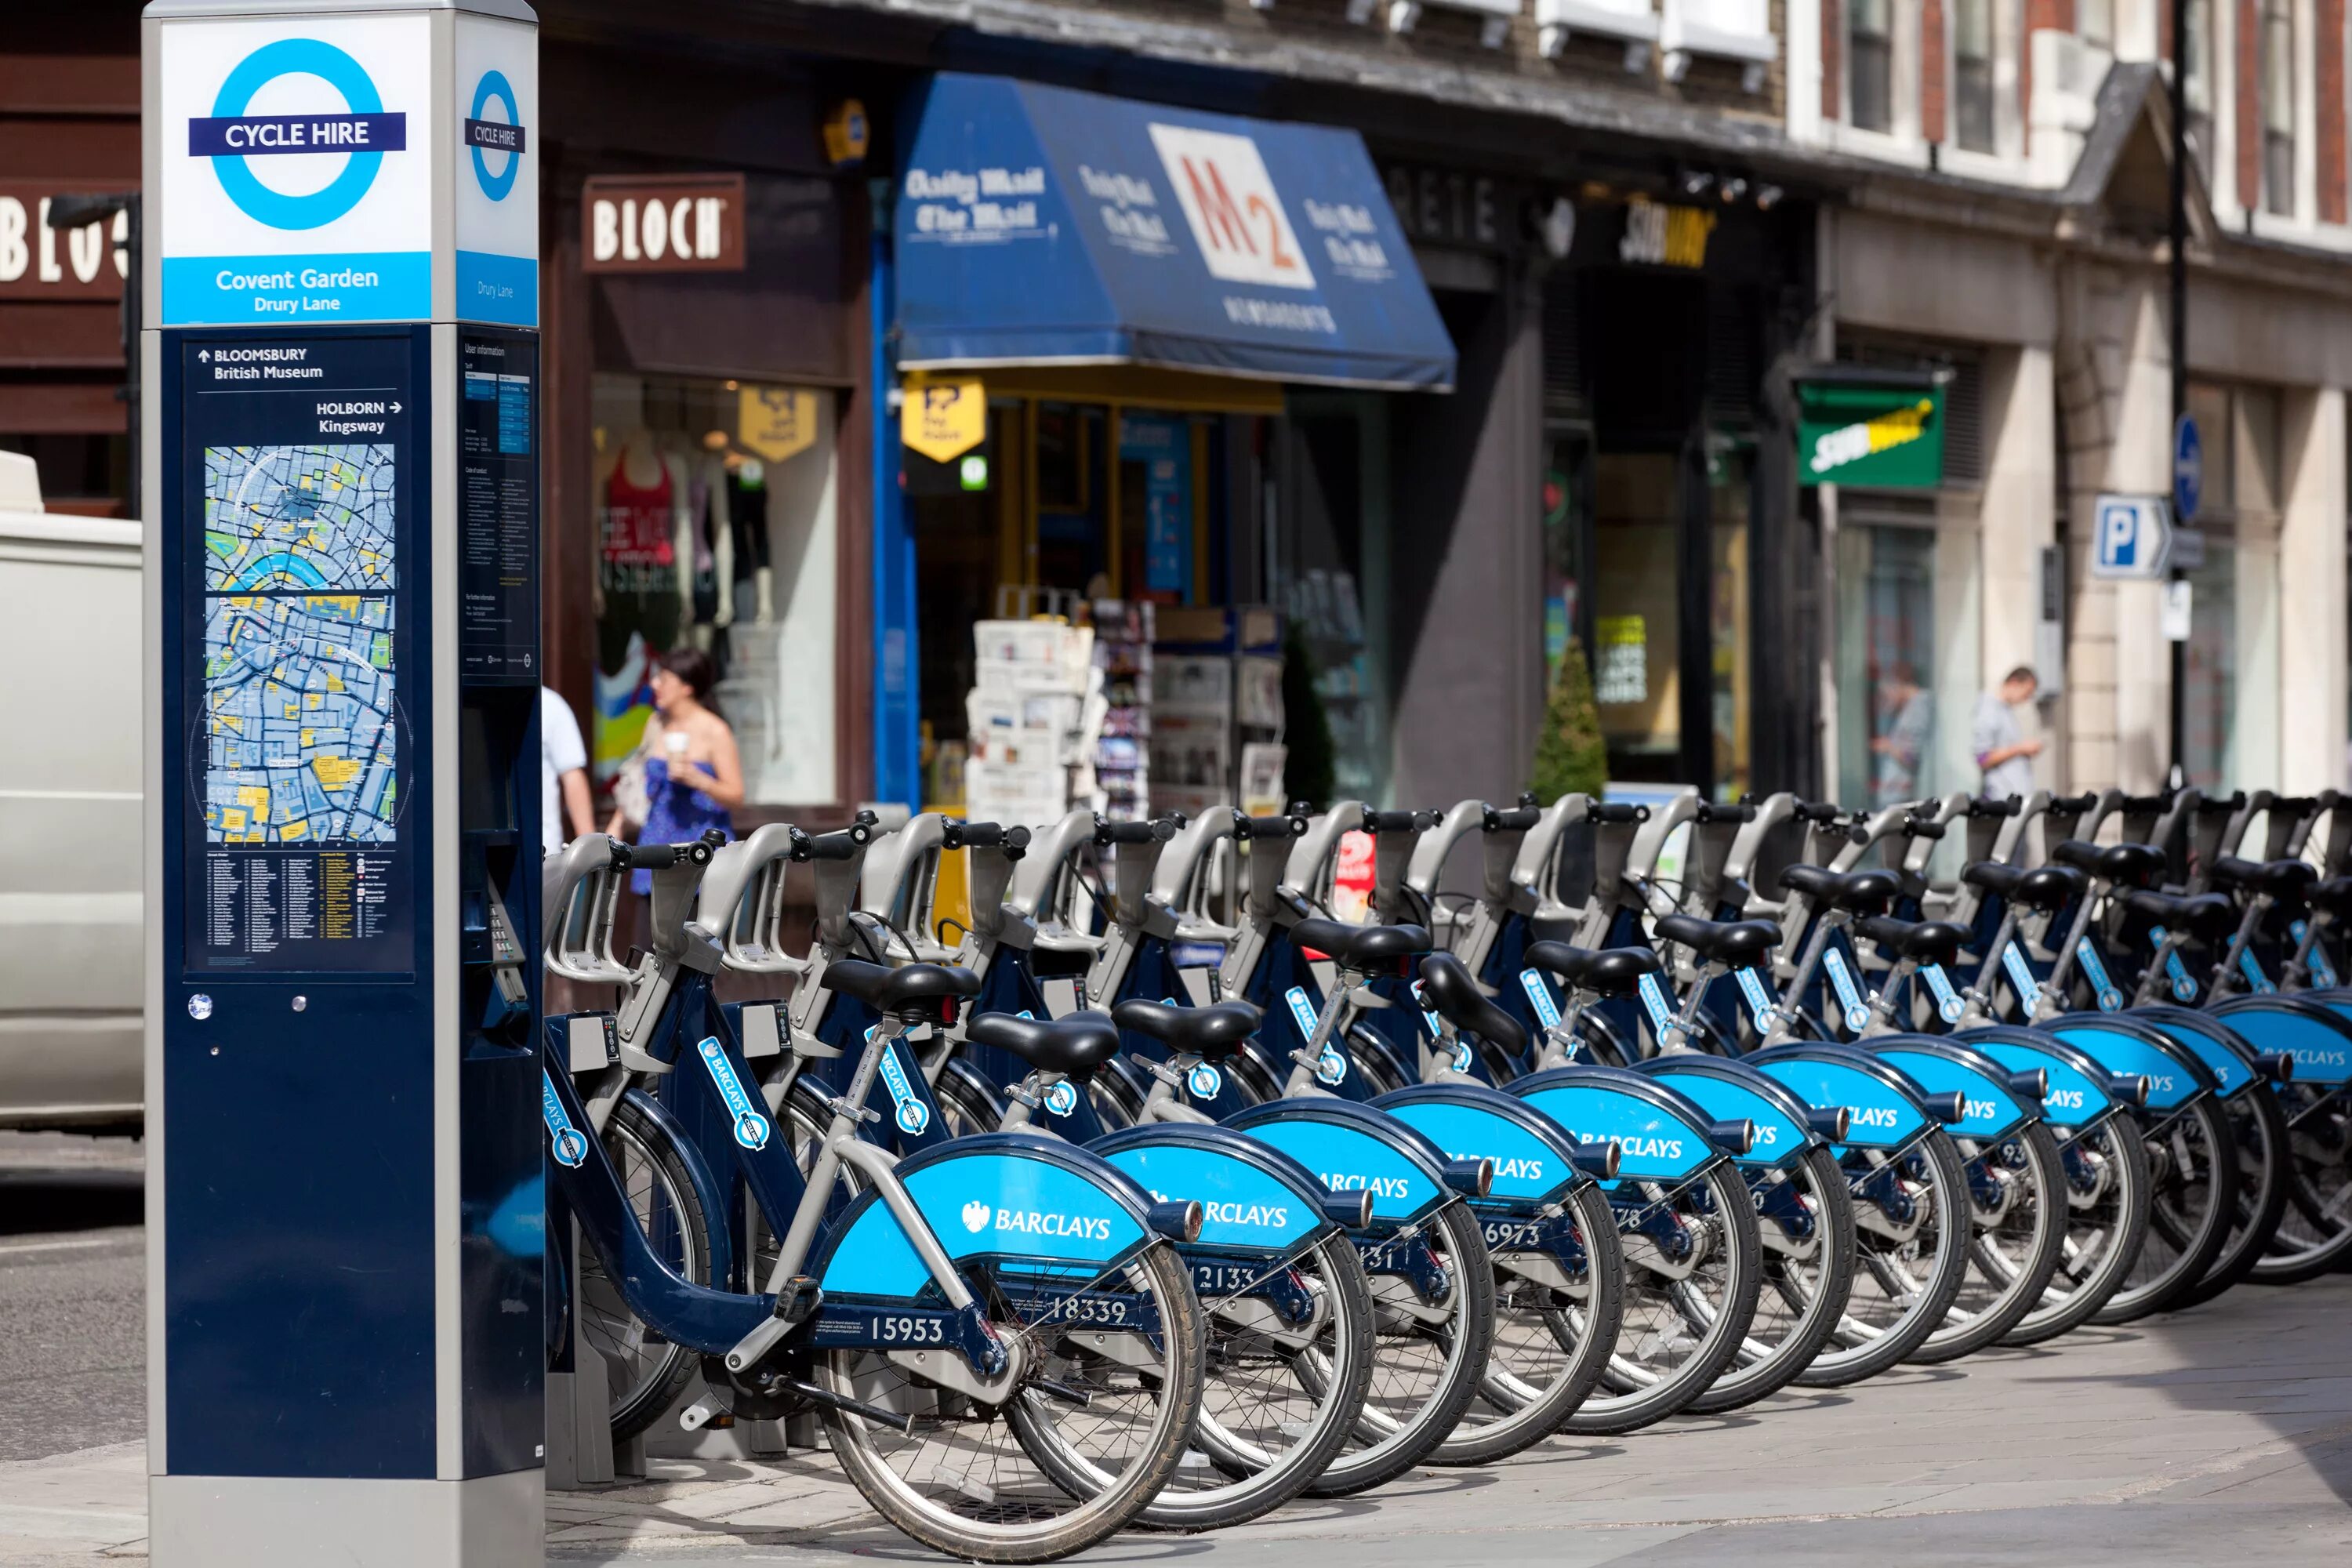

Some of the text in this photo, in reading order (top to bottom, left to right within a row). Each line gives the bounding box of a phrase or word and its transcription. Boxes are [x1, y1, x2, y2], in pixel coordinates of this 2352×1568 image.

[225, 122, 369, 147] CYCLE HIRE
[474, 125, 516, 147] CYCLE HIRE
[593, 197, 720, 261] BLOCH
[216, 268, 379, 291] Covent Garden
[477, 280, 514, 299] Drury Lane
[255, 296, 340, 314] Drury Lane
[215, 348, 307, 361] BLOOMSBURY
[465, 343, 505, 356] User information
[215, 366, 323, 379] British Museum
[317, 401, 385, 415] HOLBORN
[319, 420, 385, 435] Kingsway
[712, 1058, 745, 1110] BARCLAYS
[883, 1053, 906, 1097] ARCLAYS
[543, 1086, 563, 1126] RCLAYS
[745, 1118, 760, 1144] CYCLE HIRE
[562, 1134, 577, 1160] CYCLE HIRE
[1319, 1172, 1409, 1199] ARCLAYS
[995, 1208, 1111, 1240] BARCLAYS
[1204, 1202, 1288, 1229] RCLAYS
[1483, 1222, 1539, 1246] 6973
[1053, 1297, 1127, 1323] 18339
[873, 1317, 942, 1342] 15953
